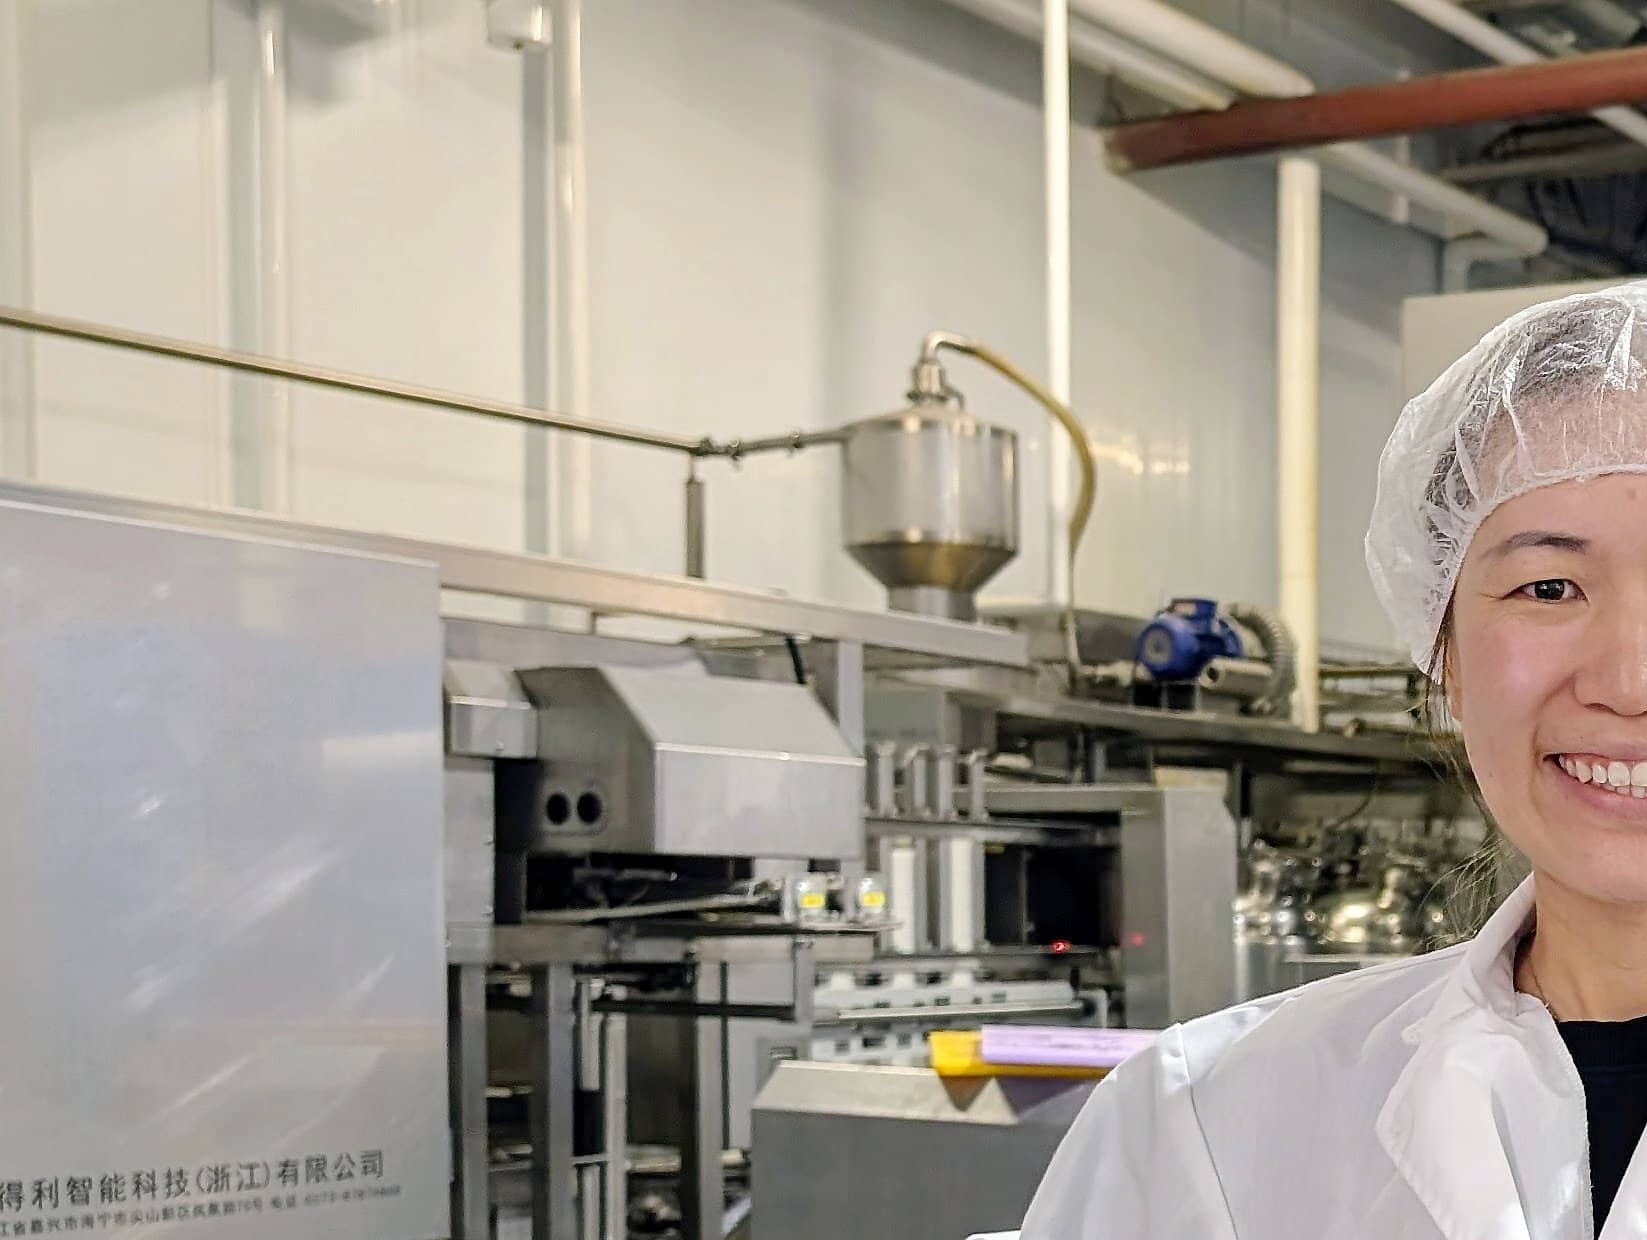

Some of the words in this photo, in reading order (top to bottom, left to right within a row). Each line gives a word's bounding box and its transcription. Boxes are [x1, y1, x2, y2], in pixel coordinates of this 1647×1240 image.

[0, 1149, 384, 1212] 得利智能科技(浙江)有限公司
